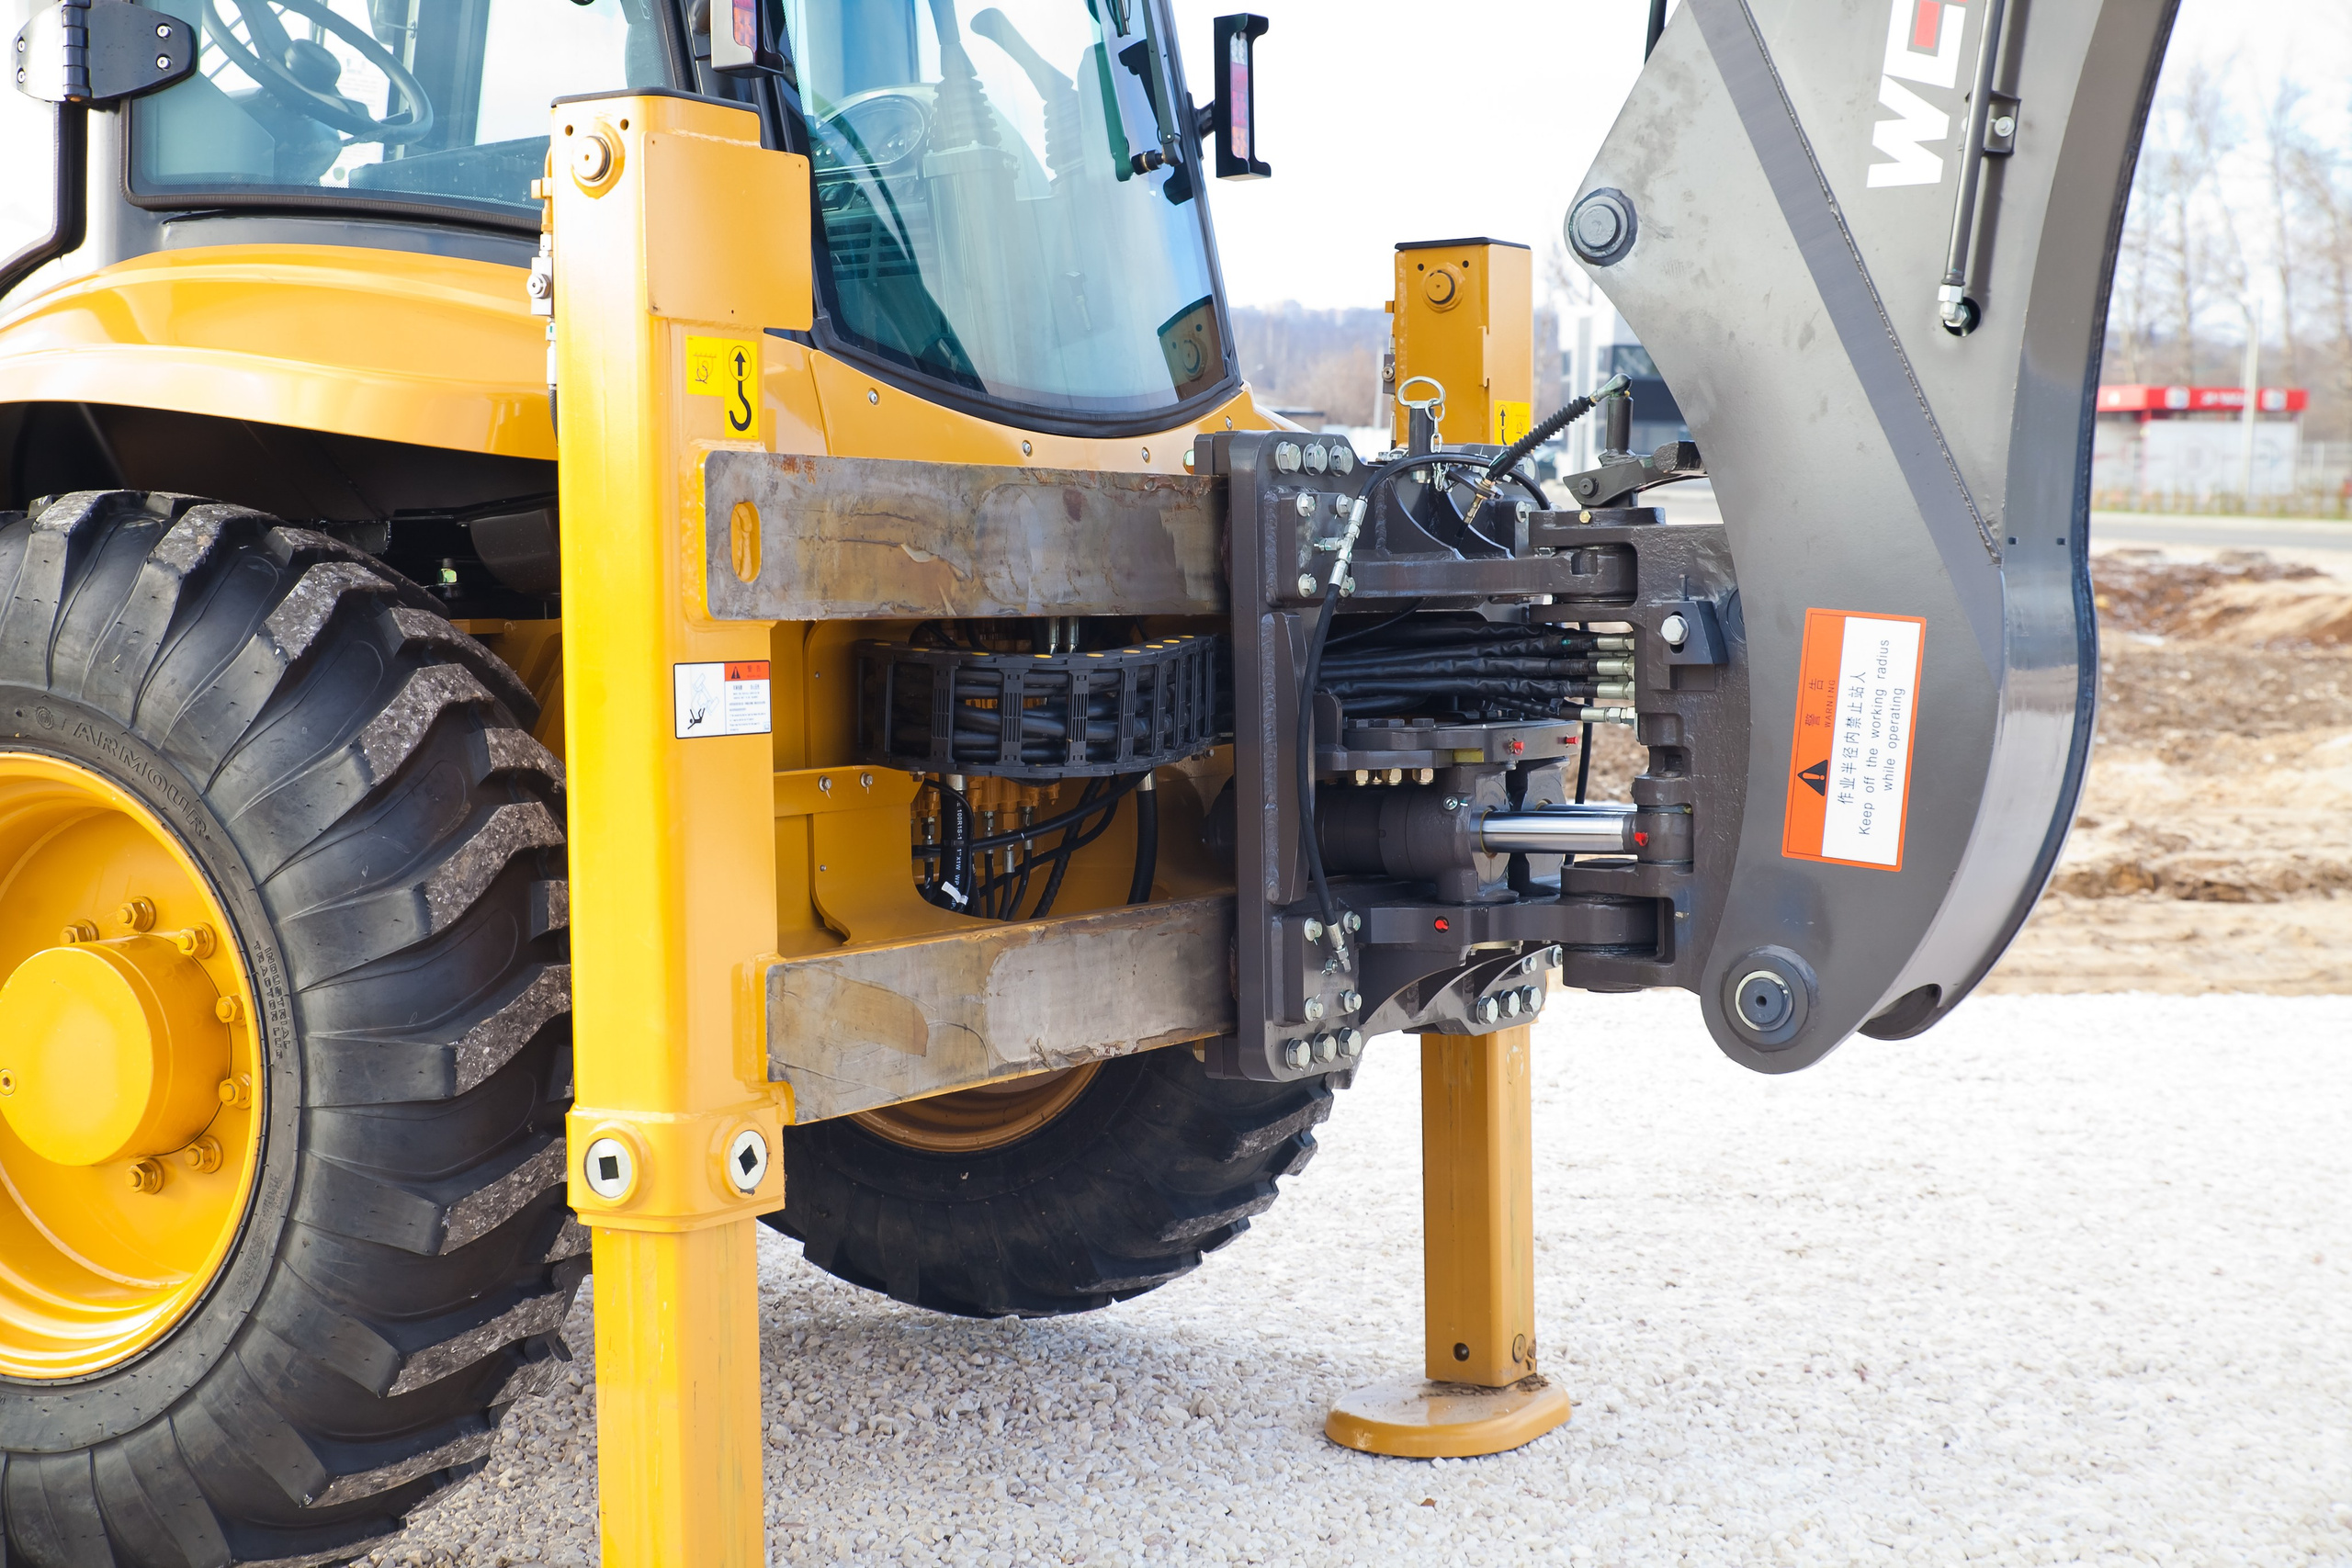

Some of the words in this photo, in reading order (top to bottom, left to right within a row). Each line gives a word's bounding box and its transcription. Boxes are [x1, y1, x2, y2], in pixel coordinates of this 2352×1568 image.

[1876, 638, 1890, 680] radius
[1824, 679, 1837, 728] WARNING
[1871, 688, 1888, 739] working
[1888, 687, 1906, 750] operating
[1837, 671, 1867, 806] 作业半径内禁止站人
[1866, 747, 1879, 768] the
[73, 721, 208, 838] ARMOUR
[1863, 775, 1876, 794] off
[1883, 759, 1896, 792] while
[1858, 802, 1875, 836] Keep
[955, 874, 961, 886] WP
[253, 941, 279, 1022] TRACTOR
[273, 1027, 284, 1059] LUG
[265, 946, 291, 1050] INDUSTRIAL
